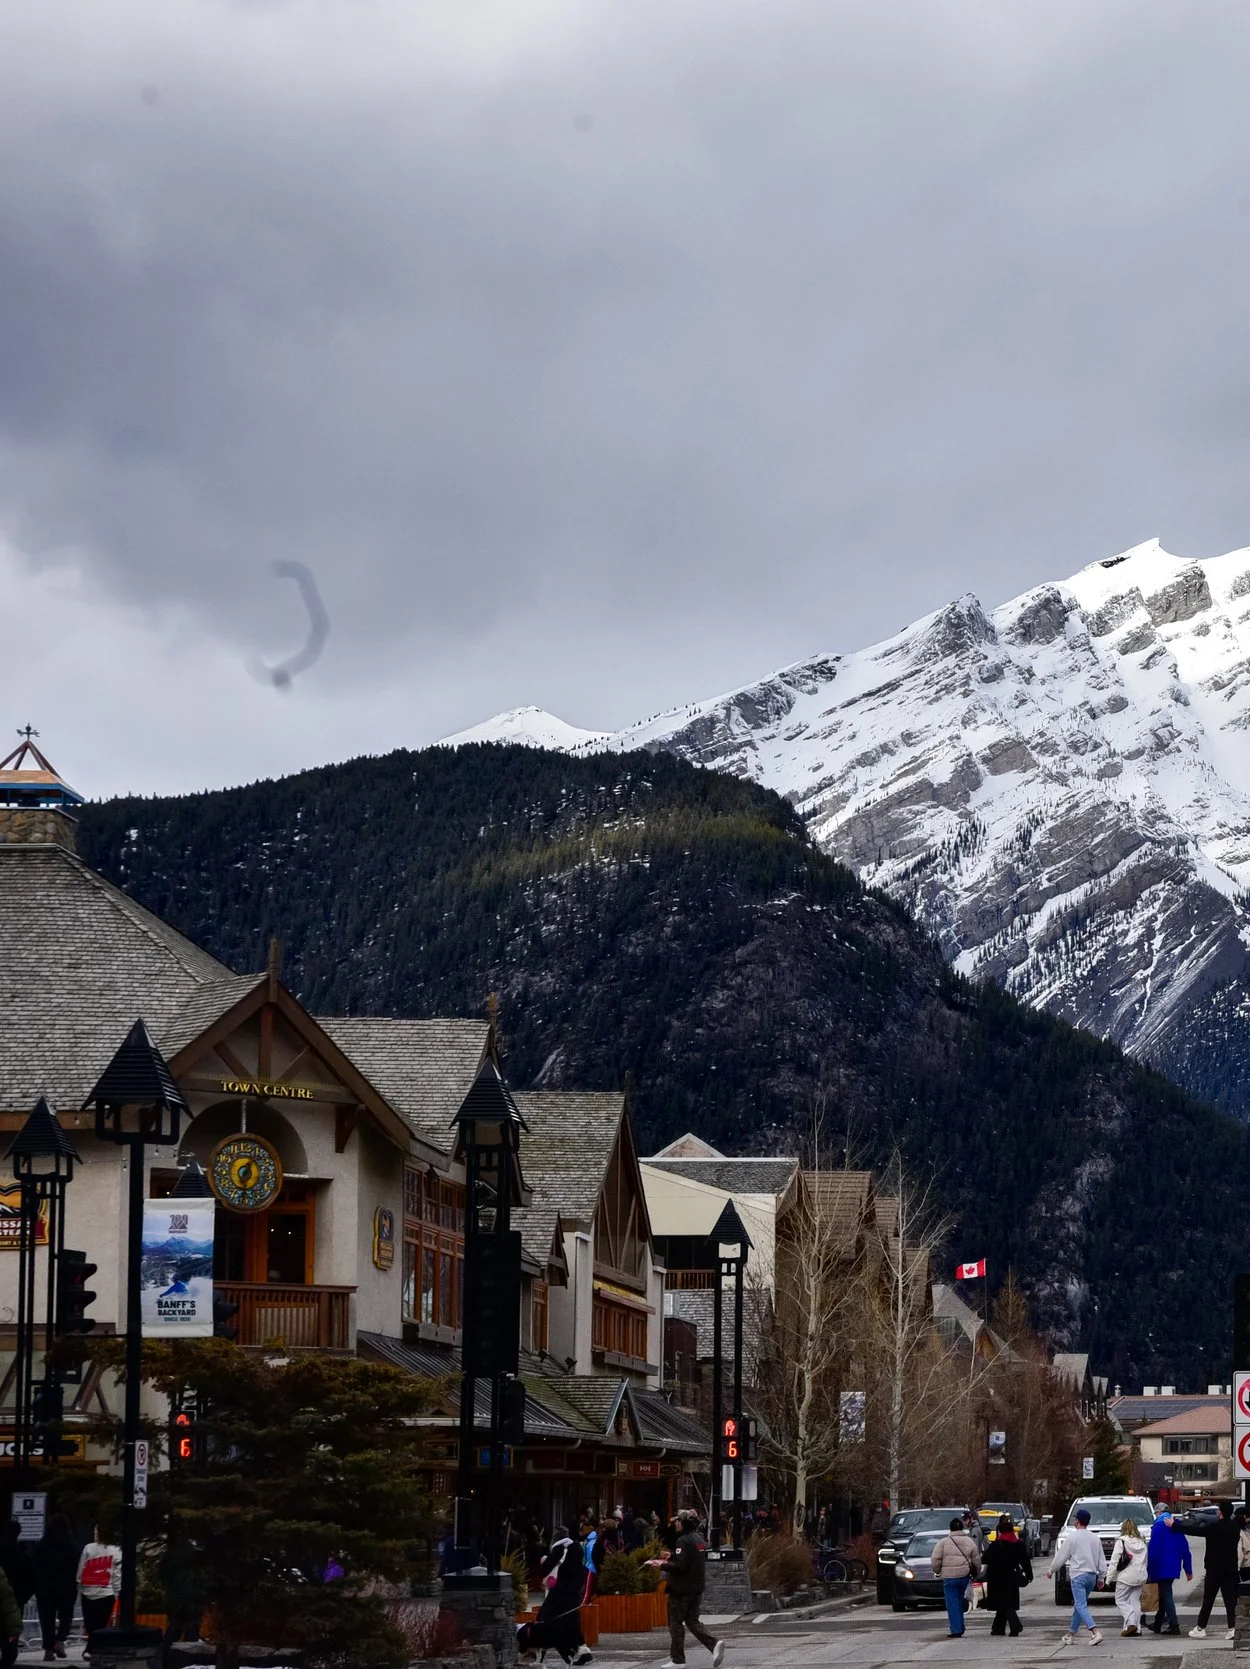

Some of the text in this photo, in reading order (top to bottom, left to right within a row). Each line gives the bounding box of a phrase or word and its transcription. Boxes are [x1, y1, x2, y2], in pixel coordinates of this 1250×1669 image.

[220, 1081, 314, 1099] TOWN CENTRE
[240, 1142, 251, 1152] 12
[157, 1300, 196, 1308] BANFF'S
[180, 1438, 190, 1457] 6
[728, 1441, 737, 1458] 6
